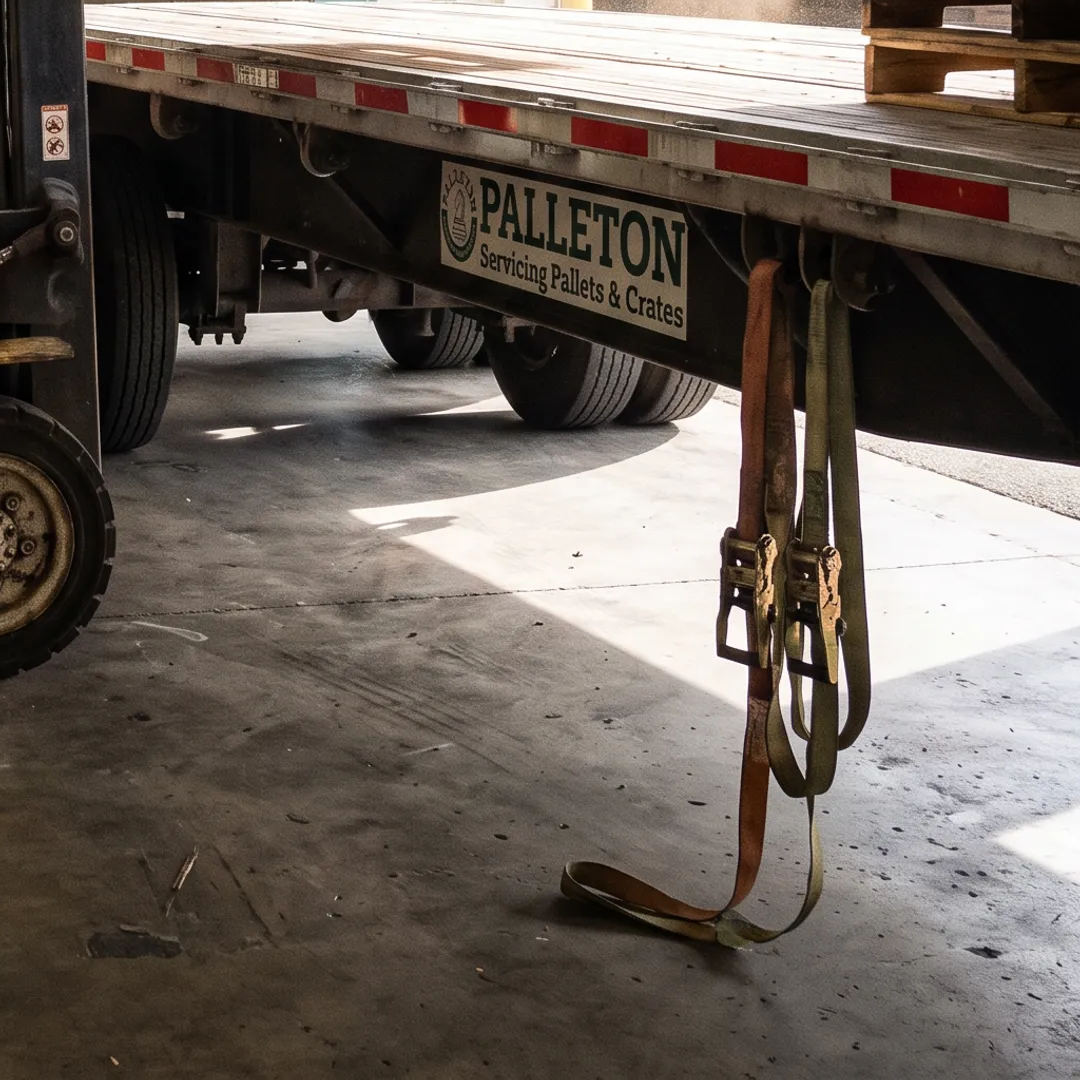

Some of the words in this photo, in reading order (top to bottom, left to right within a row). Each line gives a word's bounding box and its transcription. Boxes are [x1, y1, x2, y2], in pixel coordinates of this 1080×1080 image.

[480, 176, 686, 288] PALLETON
[480, 243, 548, 295] Servicing
[550, 263, 605, 304] Pallets
[608, 280, 622, 310] &
[625, 285, 684, 329] Crates
